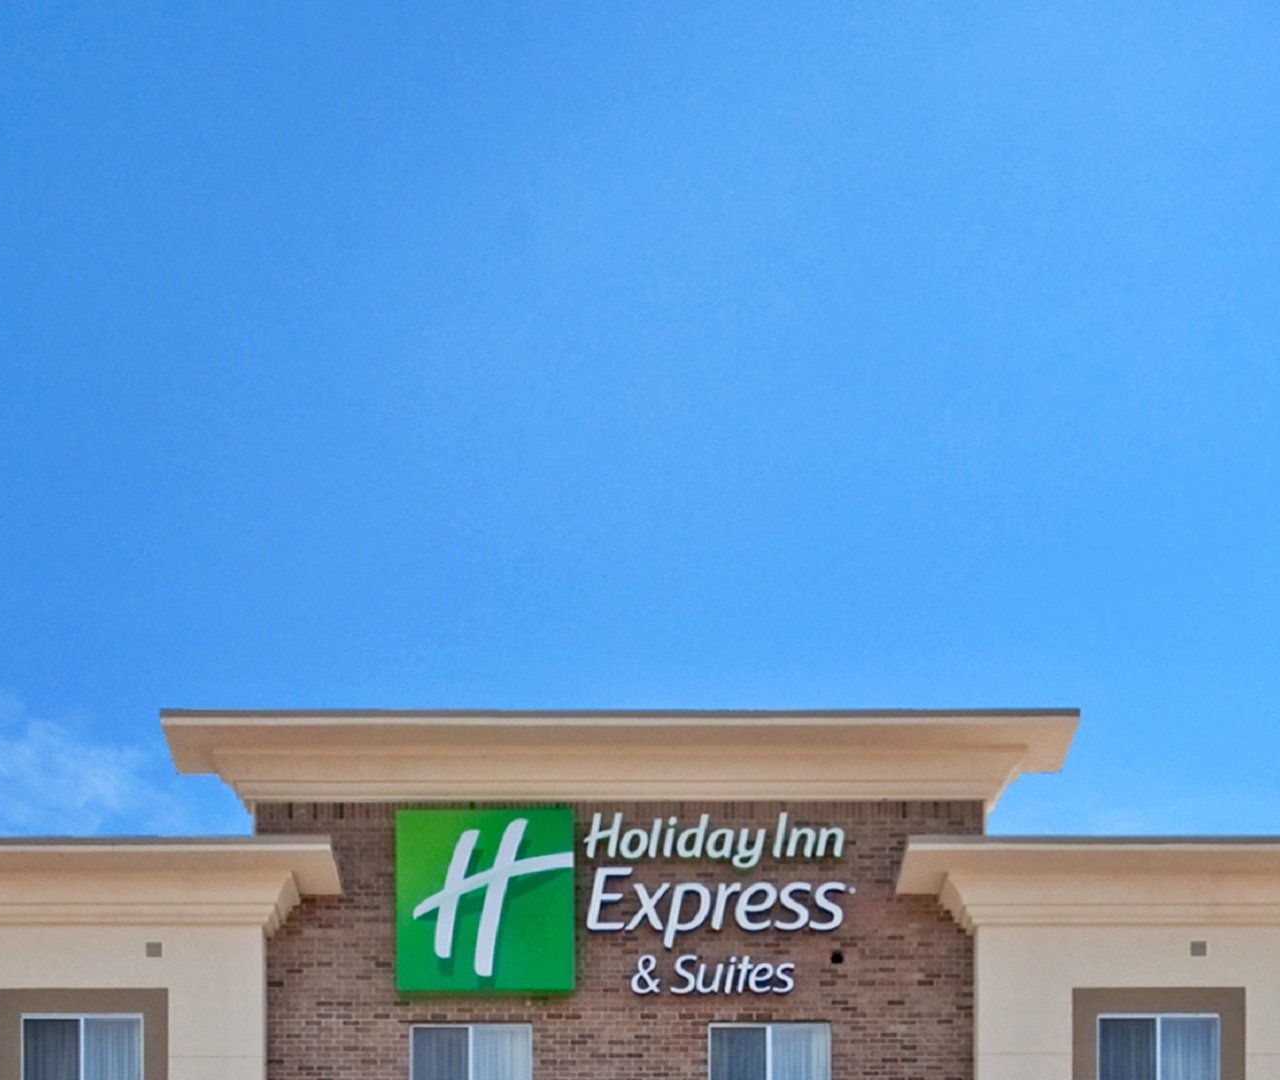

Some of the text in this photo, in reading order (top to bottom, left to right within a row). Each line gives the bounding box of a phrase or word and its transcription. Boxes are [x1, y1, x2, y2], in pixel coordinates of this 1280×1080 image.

[583, 811, 845, 869] Holiday Inn
[585, 866, 847, 949] Express
[630, 954, 795, 995] & Suites
